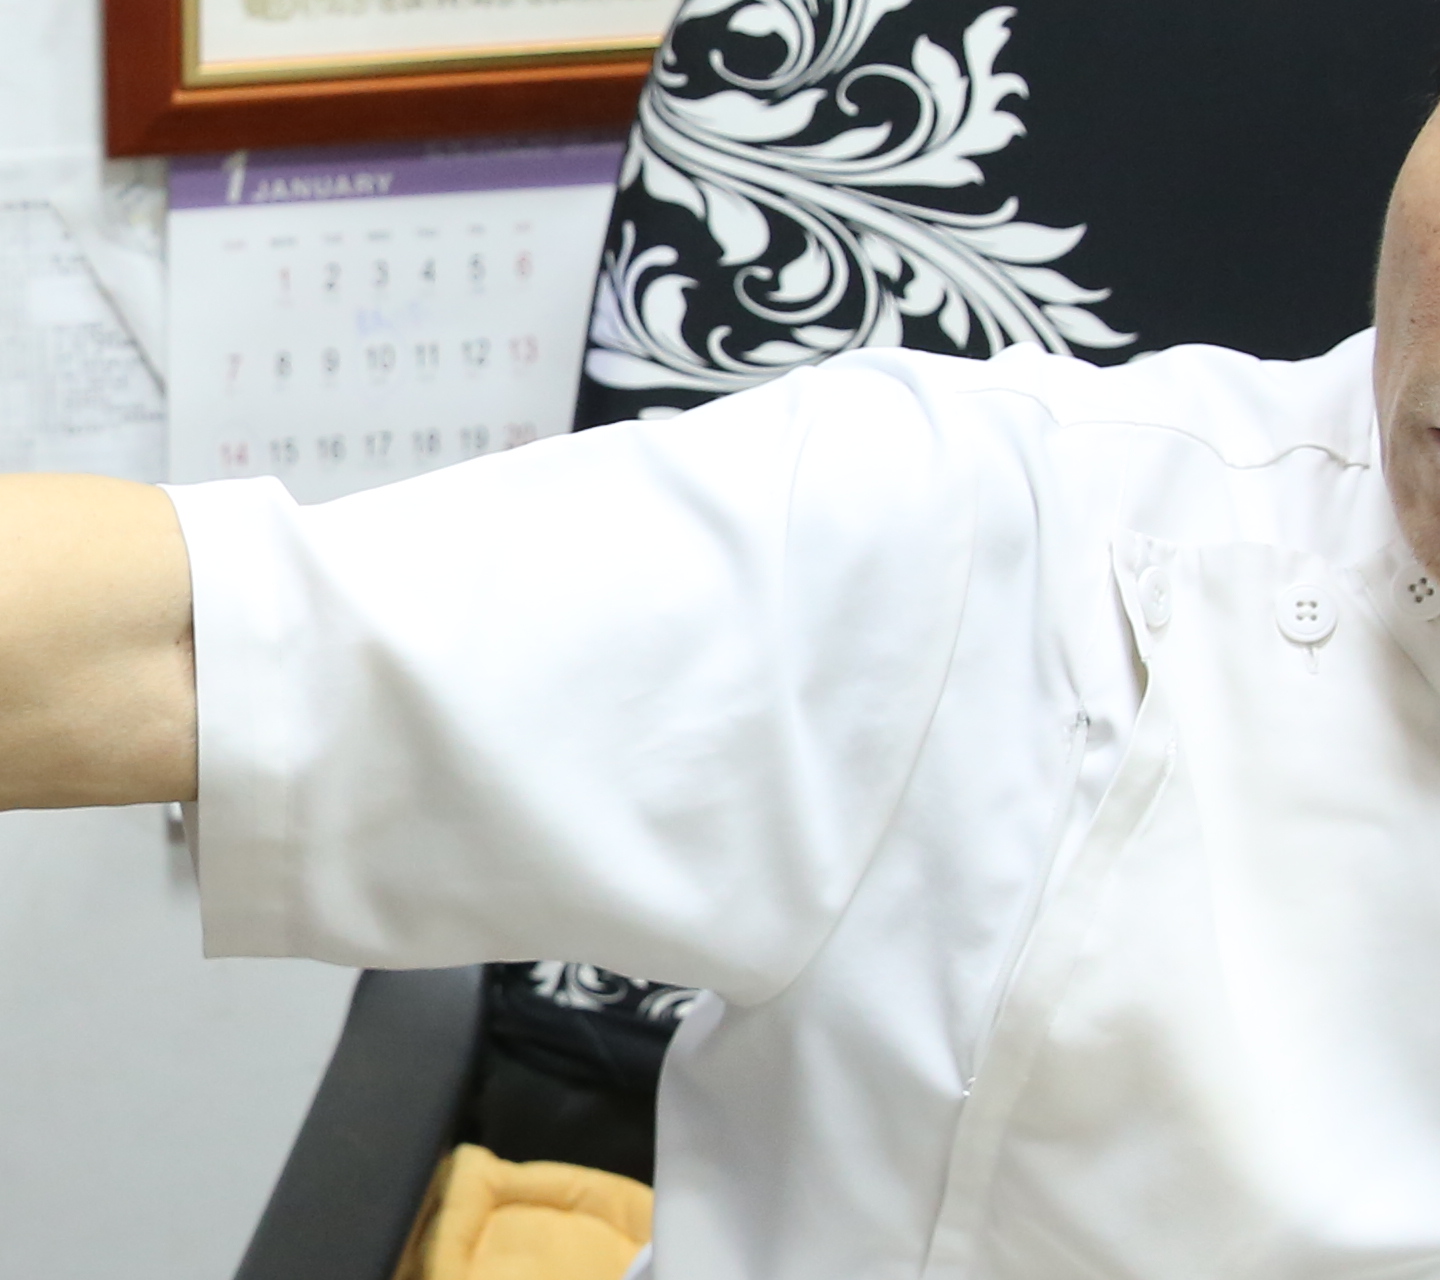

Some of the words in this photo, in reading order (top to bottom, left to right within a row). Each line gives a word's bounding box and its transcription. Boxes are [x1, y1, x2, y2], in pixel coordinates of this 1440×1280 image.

[224, 150, 249, 205] 1
[251, 171, 395, 204] JANUARY
[277, 265, 292, 293] 1
[323, 260, 342, 292] 2
[373, 258, 390, 287] 3
[422, 256, 438, 284] 4
[468, 252, 487, 281] 5
[515, 249, 533, 278] 6
[225, 351, 244, 381] 7
[274, 349, 292, 378] 8
[322, 346, 341, 375] 9
[365, 342, 398, 372] 10
[414, 341, 441, 369] 11
[461, 338, 492, 368] 12
[508, 334, 540, 365] 13
[221, 441, 249, 467] 14
[270, 437, 300, 466] 15
[317, 434, 347, 462] 16
[365, 430, 394, 459] 17
[411, 427, 441, 456] 18
[460, 426, 491, 453] 19
